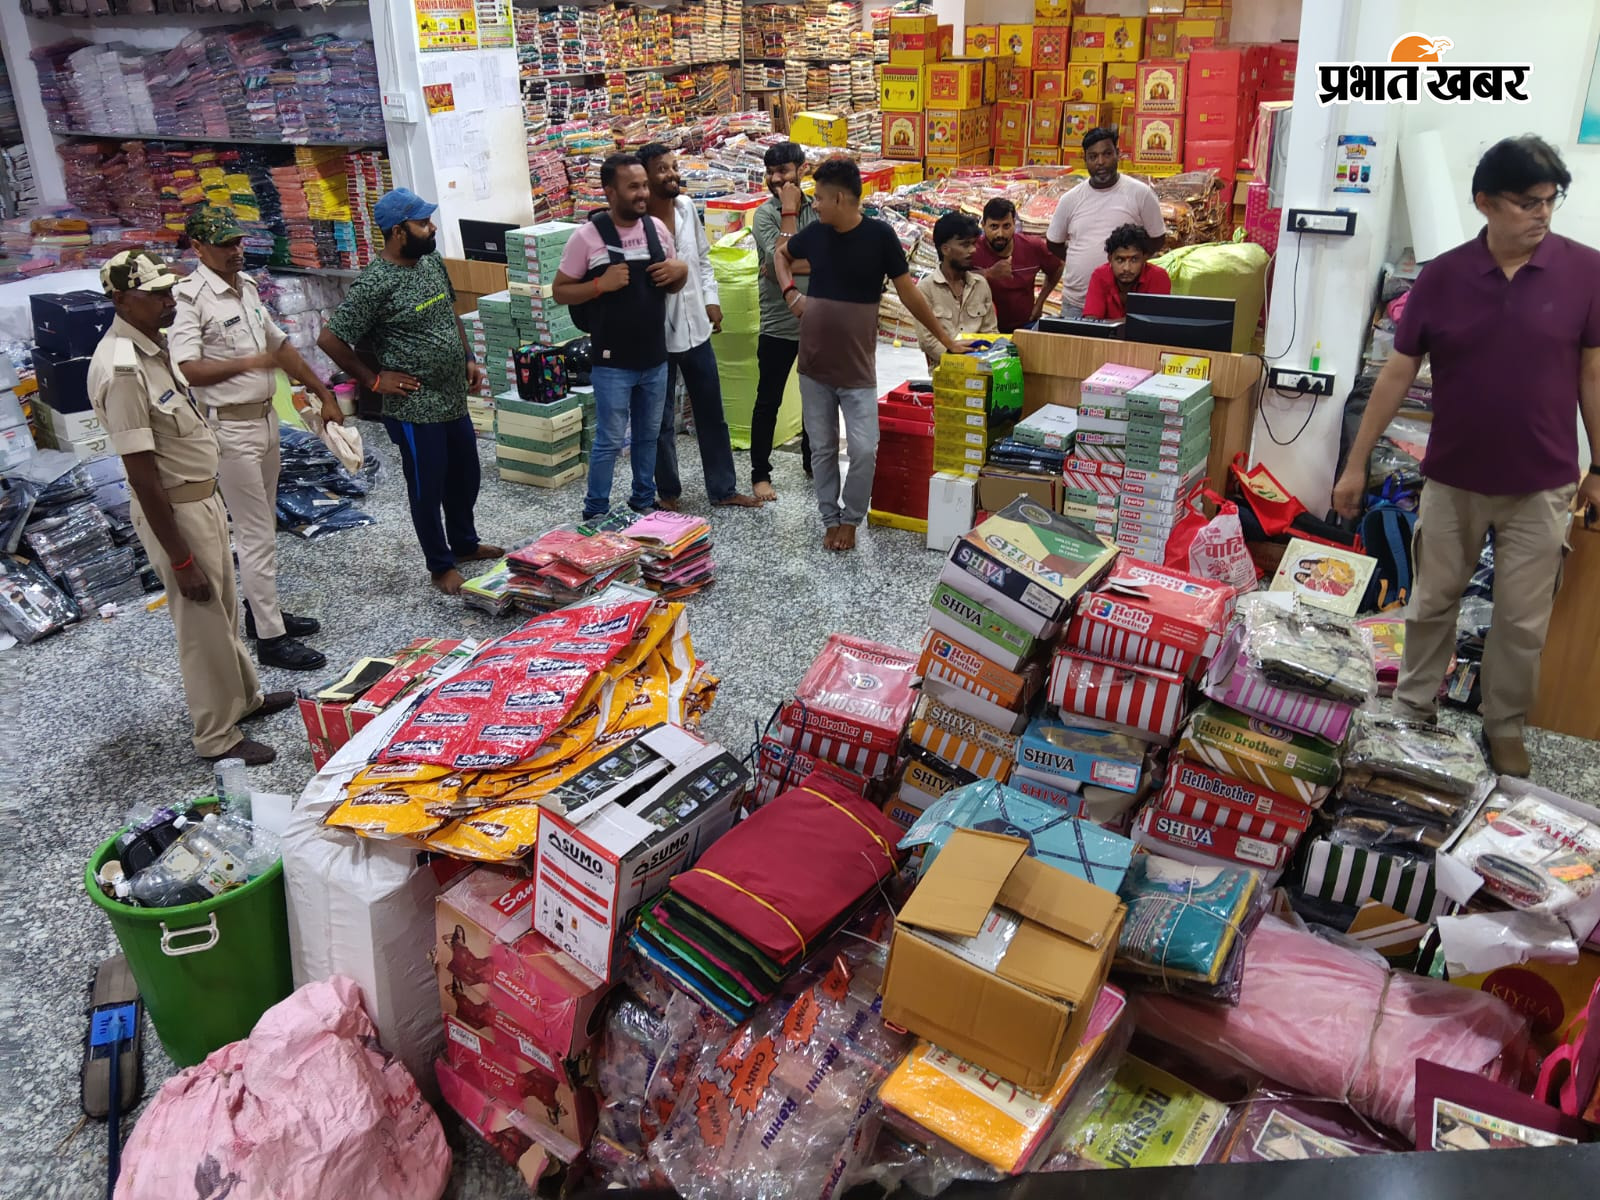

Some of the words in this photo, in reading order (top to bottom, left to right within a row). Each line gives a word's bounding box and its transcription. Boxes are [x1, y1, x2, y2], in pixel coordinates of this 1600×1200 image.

[1167, 362, 1182, 374] राधे
[1185, 363, 1201, 376] राधे
[1078, 460, 1097, 469] Hello
[1126, 471, 1146, 480] Sparky
[1124, 498, 1144, 506] Sparky
[959, 548, 1005, 587] SHIVA
[985, 534, 1063, 587] SHIVA
[940, 594, 983, 626] SHIVA
[1114, 604, 1151, 625] Hello
[580, 616, 628, 635] Sanjay
[1110, 614, 1148, 632] Brother
[838, 646, 885, 663] Brother
[949, 655, 978, 676] Brother
[951, 647, 981, 670] Hello
[442, 680, 493, 694] Sanjay
[816, 689, 893, 722] AWESOME
[415, 713, 469, 725] Sanjay
[819, 715, 860, 737] Brother
[931, 706, 976, 736] SHIVA
[1200, 720, 1232, 740] Hello
[1234, 732, 1283, 758] Brother
[1023, 748, 1075, 773] SHIVA
[1021, 783, 1069, 808] SHIVA
[1180, 768, 1211, 790] Hello
[1212, 777, 1254, 804] Brother
[1156, 816, 1213, 846] SHIVA
[562, 837, 604, 874] SUMO
[650, 832, 690, 866] SUMO
[499, 882, 533, 912] San
[496, 970, 541, 1007] Sanjay
[1105, 1087, 1172, 1169] RESHMA
